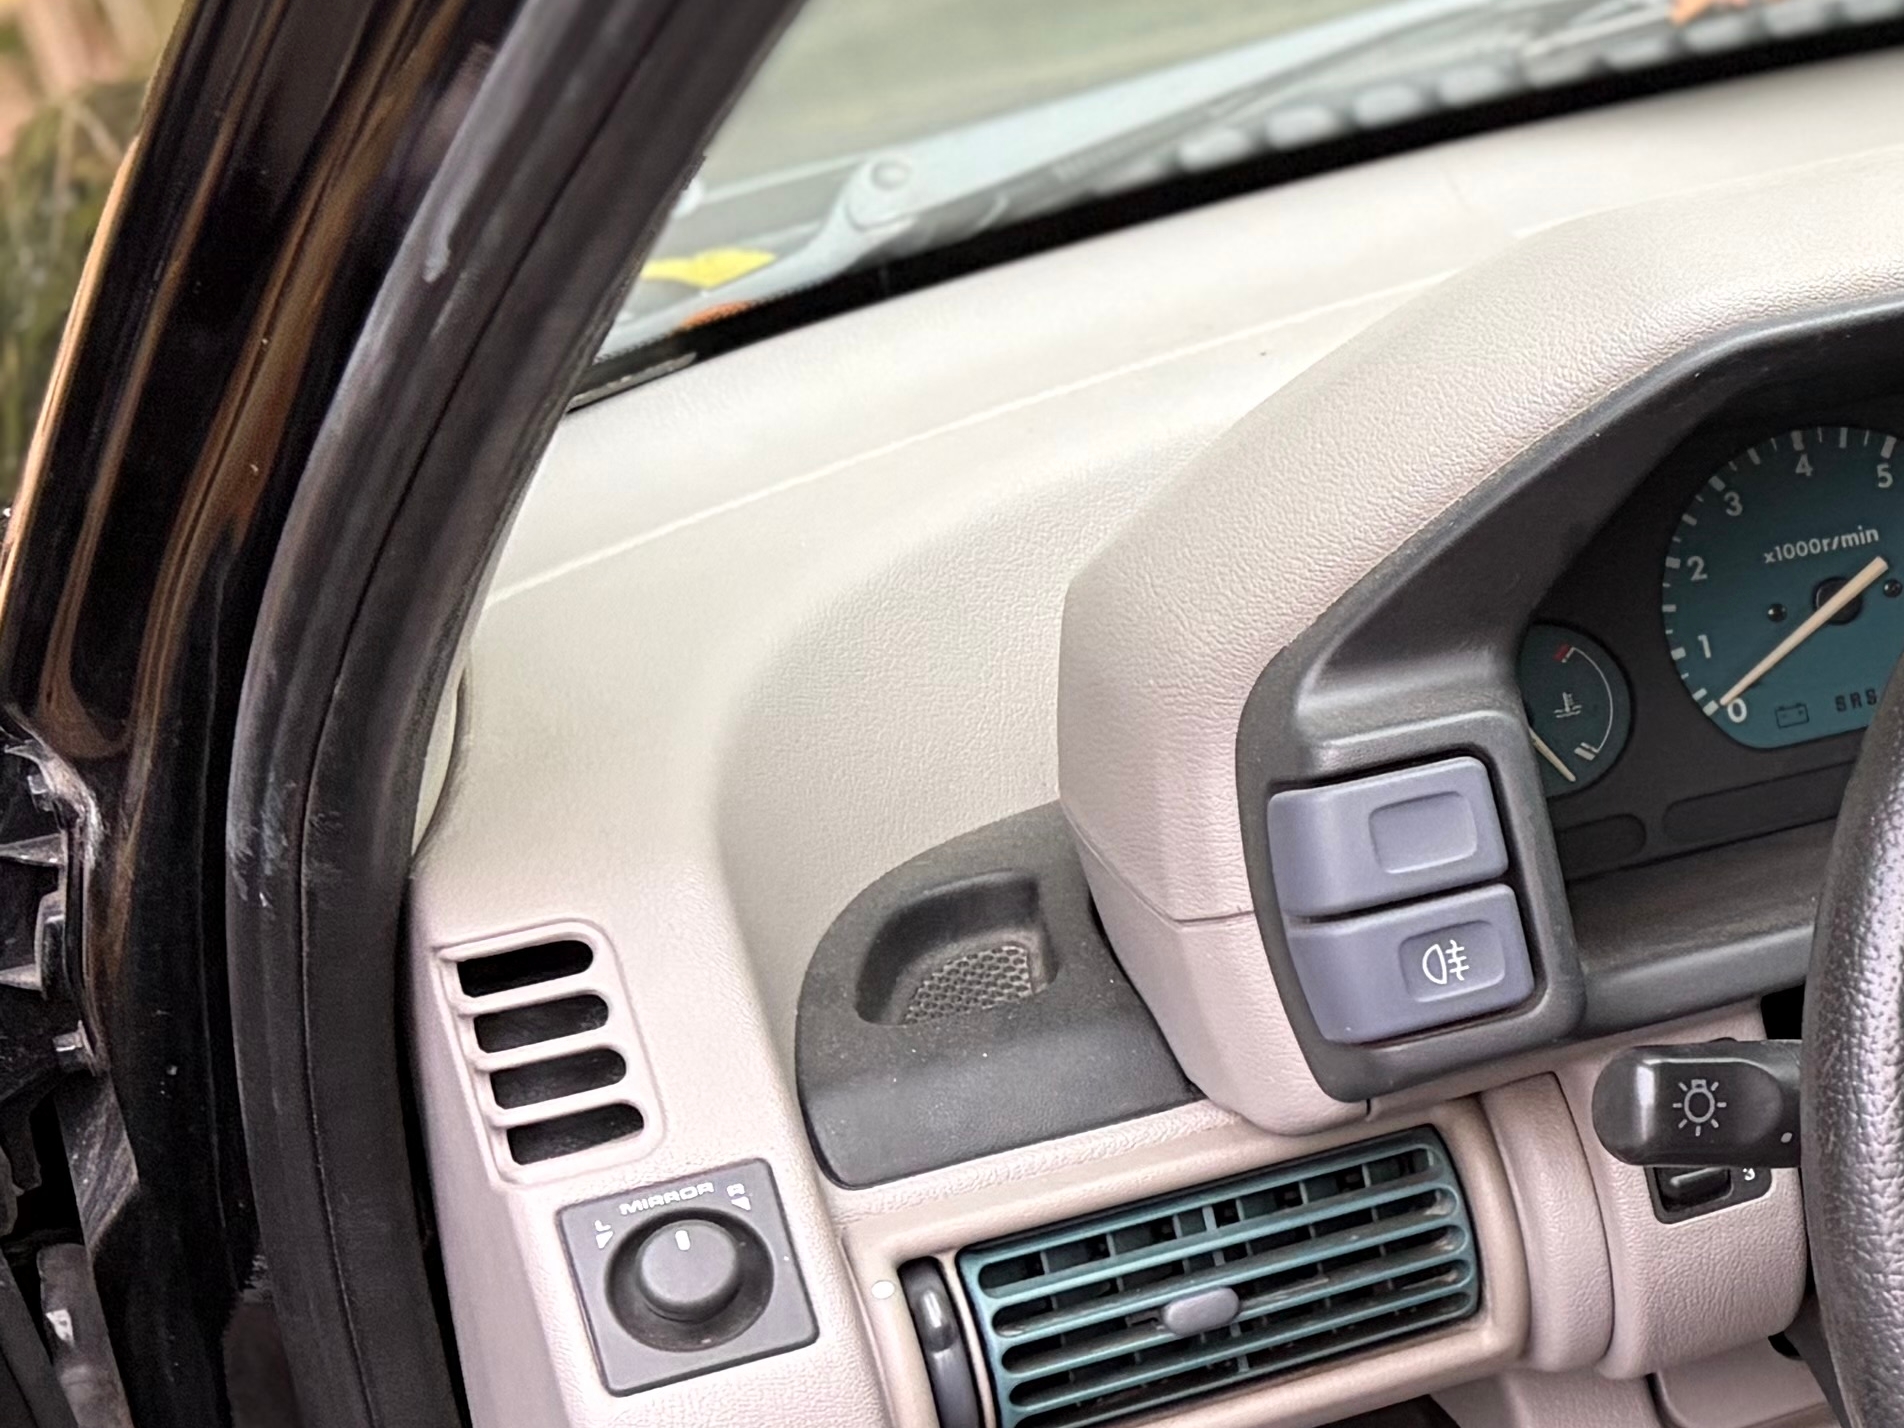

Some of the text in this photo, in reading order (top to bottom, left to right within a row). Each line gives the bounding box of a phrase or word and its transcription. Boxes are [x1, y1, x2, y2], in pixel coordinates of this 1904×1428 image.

[1795, 453, 1813, 477] 4
[1876, 463, 1894, 489] 5
[1723, 491, 1744, 517] 3
[1763, 525, 1881, 565] x1000r/min
[1686, 555, 1709, 582] 2
[1697, 633, 1712, 659] 1
[1726, 698, 1749, 724] 0
[1834, 687, 1877, 713] SRS
[618, 1182, 716, 1216] MIRROR
[726, 1182, 746, 1197] R
[594, 1219, 612, 1232] L
